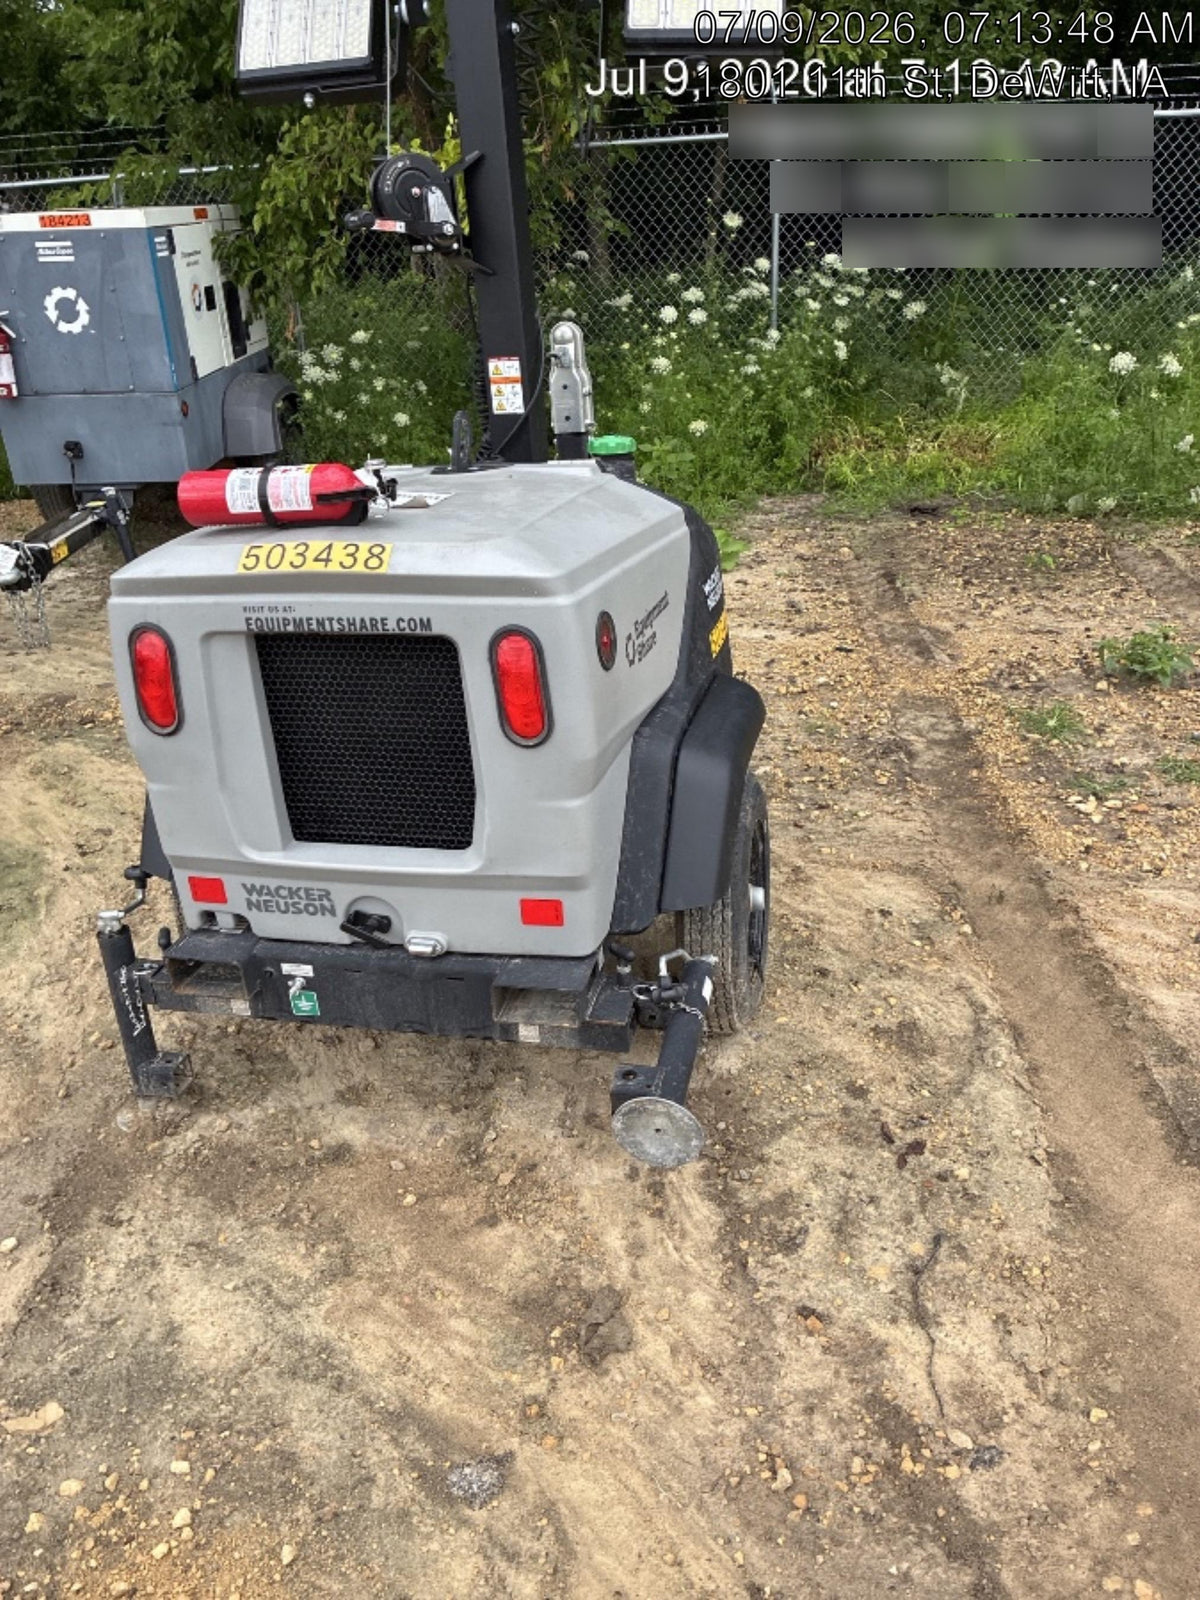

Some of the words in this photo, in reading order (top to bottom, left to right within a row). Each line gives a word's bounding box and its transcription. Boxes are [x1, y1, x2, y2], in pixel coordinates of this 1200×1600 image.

[242, 542, 386, 571] 503438
[243, 606, 265, 614] VISIT
[268, 606, 280, 614] US
[244, 616, 433, 633] EQUIPMENTSHARE.COM
[241, 882, 333, 902] WACKER
[245, 897, 337, 918] NEUSON
